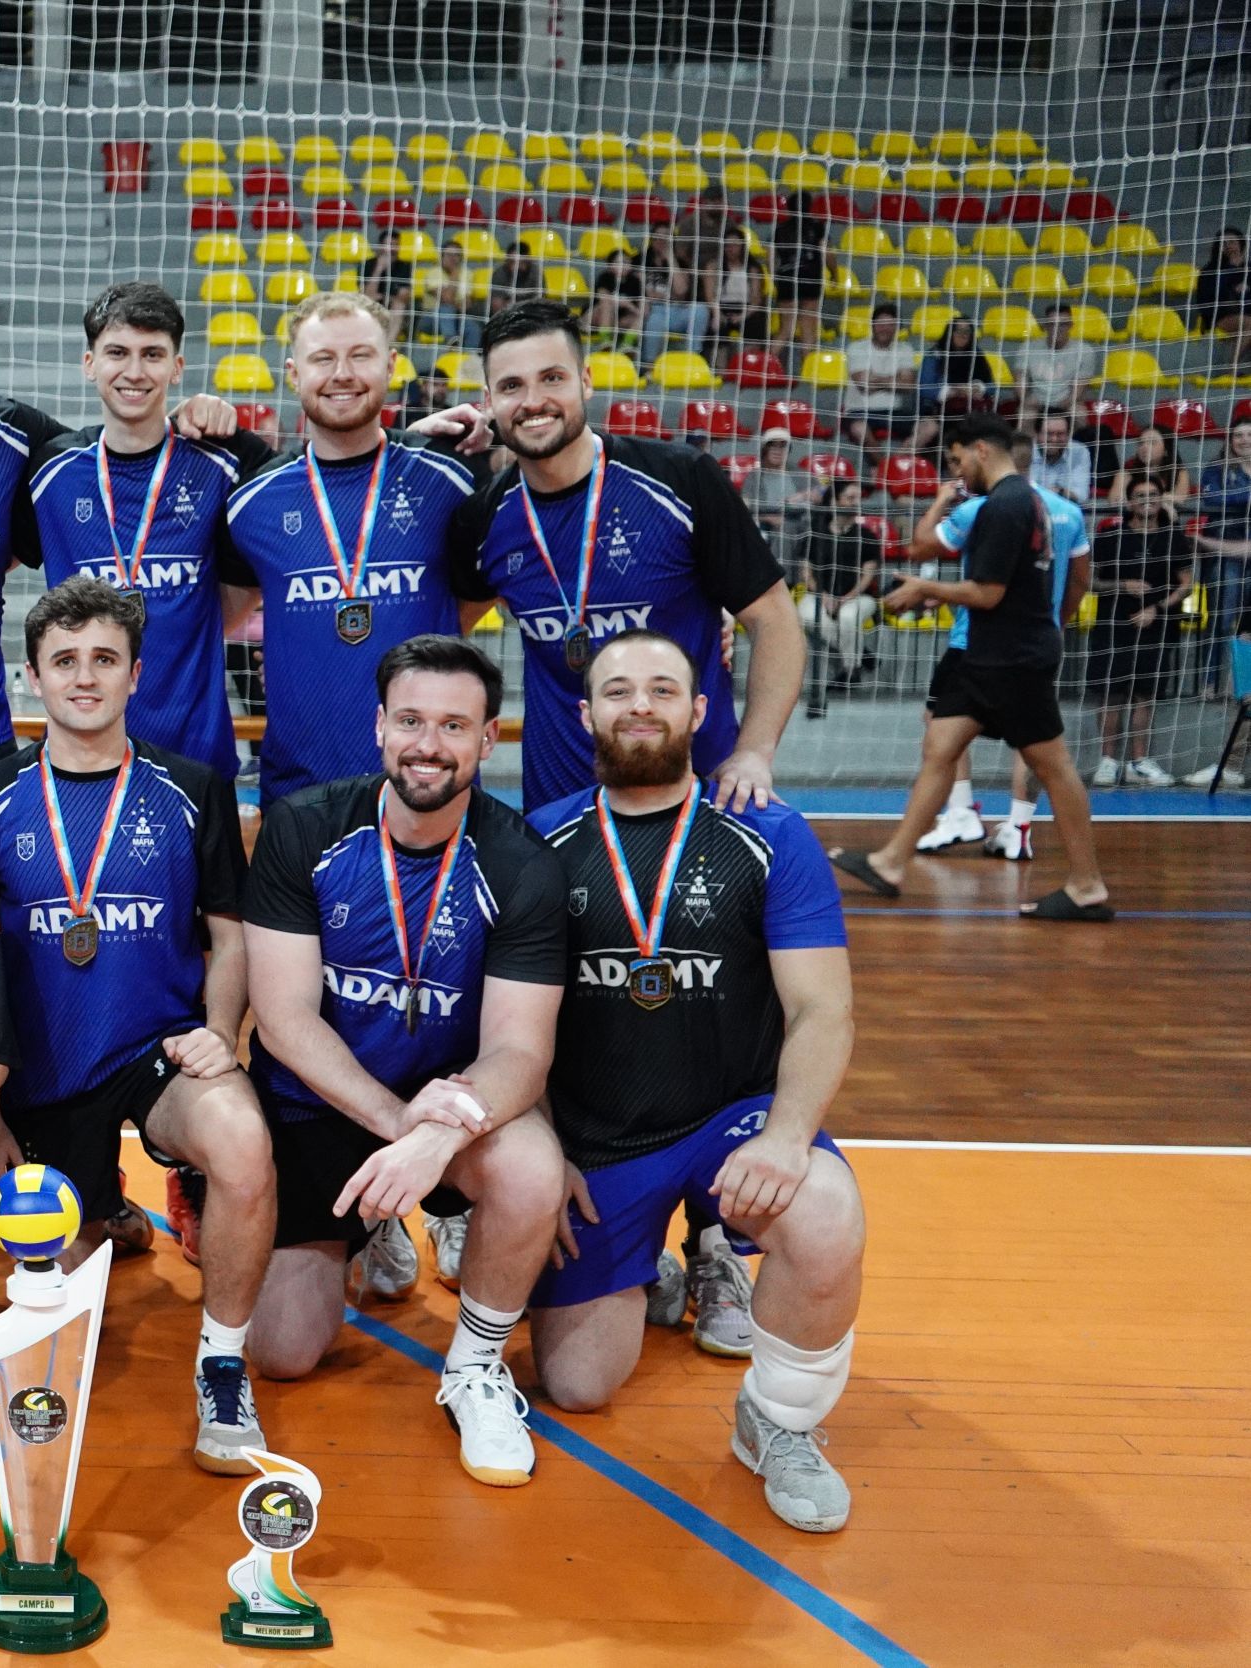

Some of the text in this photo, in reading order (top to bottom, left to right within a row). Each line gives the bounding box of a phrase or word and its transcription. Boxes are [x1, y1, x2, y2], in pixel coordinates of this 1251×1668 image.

[518, 605, 653, 642] ADMY
[578, 958, 724, 990] ADMY
[18, 1598, 55, 1609] CAMPEÃO
[255, 1627, 281, 1636] MELHOR
